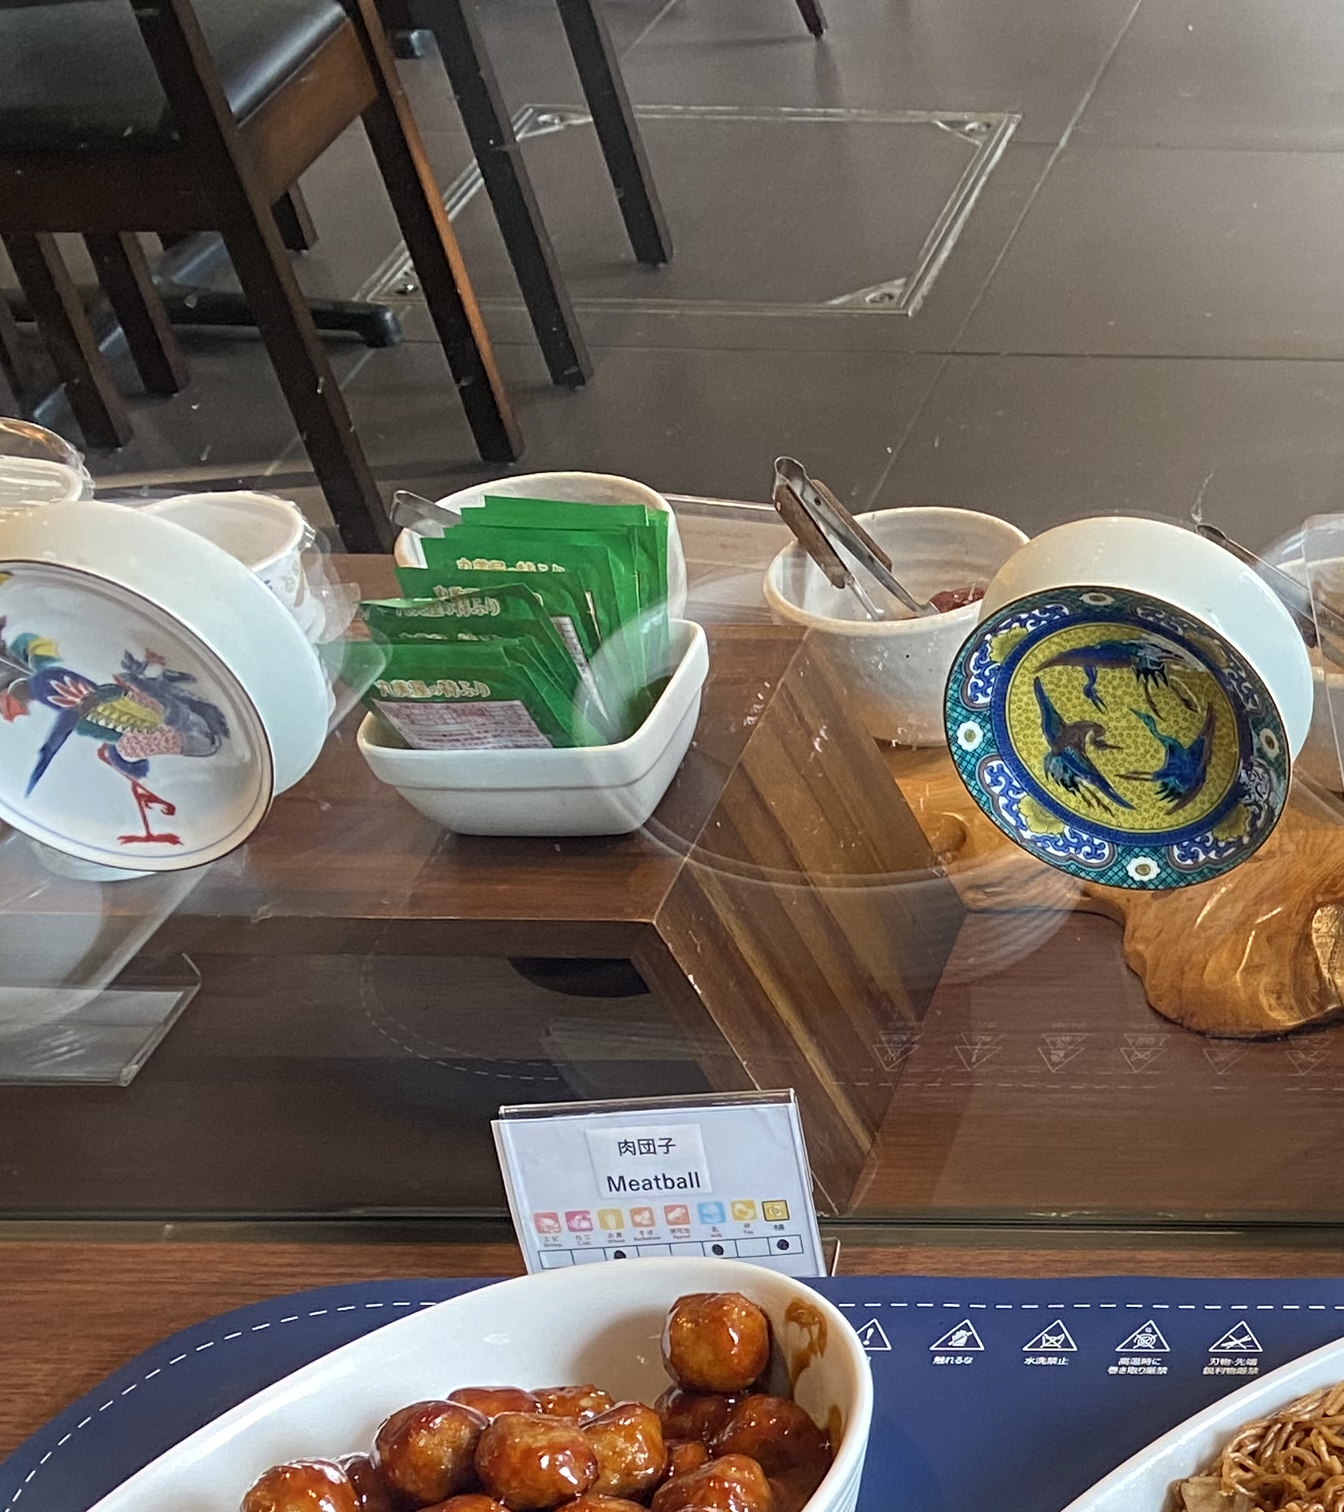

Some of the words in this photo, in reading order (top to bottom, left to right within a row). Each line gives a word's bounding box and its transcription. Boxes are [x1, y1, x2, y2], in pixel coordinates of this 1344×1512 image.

[617, 1137, 676, 1157] 肉団子
[606, 1171, 701, 1193] Meatball
